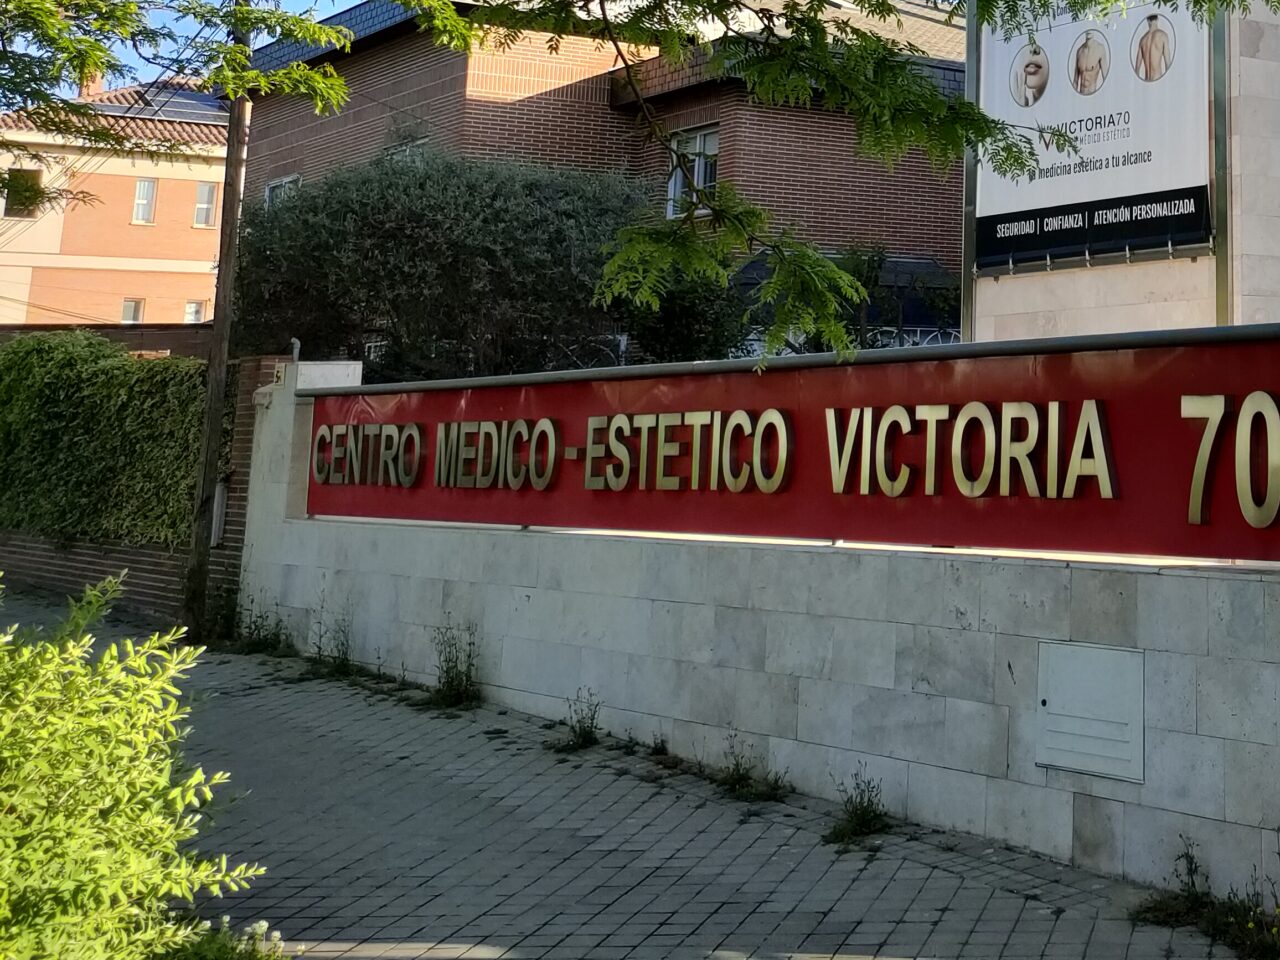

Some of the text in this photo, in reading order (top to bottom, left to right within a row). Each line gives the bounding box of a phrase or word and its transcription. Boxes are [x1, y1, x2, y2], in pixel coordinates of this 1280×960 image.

[1102, 128, 1131, 141] ESTÉTICO
[1039, 161, 1072, 179] medicina
[1073, 155, 1103, 174] estética
[1104, 159, 1110, 169] a
[1111, 154, 1120, 168] tu
[1121, 150, 1152, 167] alcance
[996, 199, 1195, 238] SEGURIDAD CONFIANZA ATENCIÓN PERSONALIZADA
[311, 422, 421, 487] CENTRO
[434, 417, 557, 492] MEDICO
[825, 399, 1116, 499] VICTORIA
